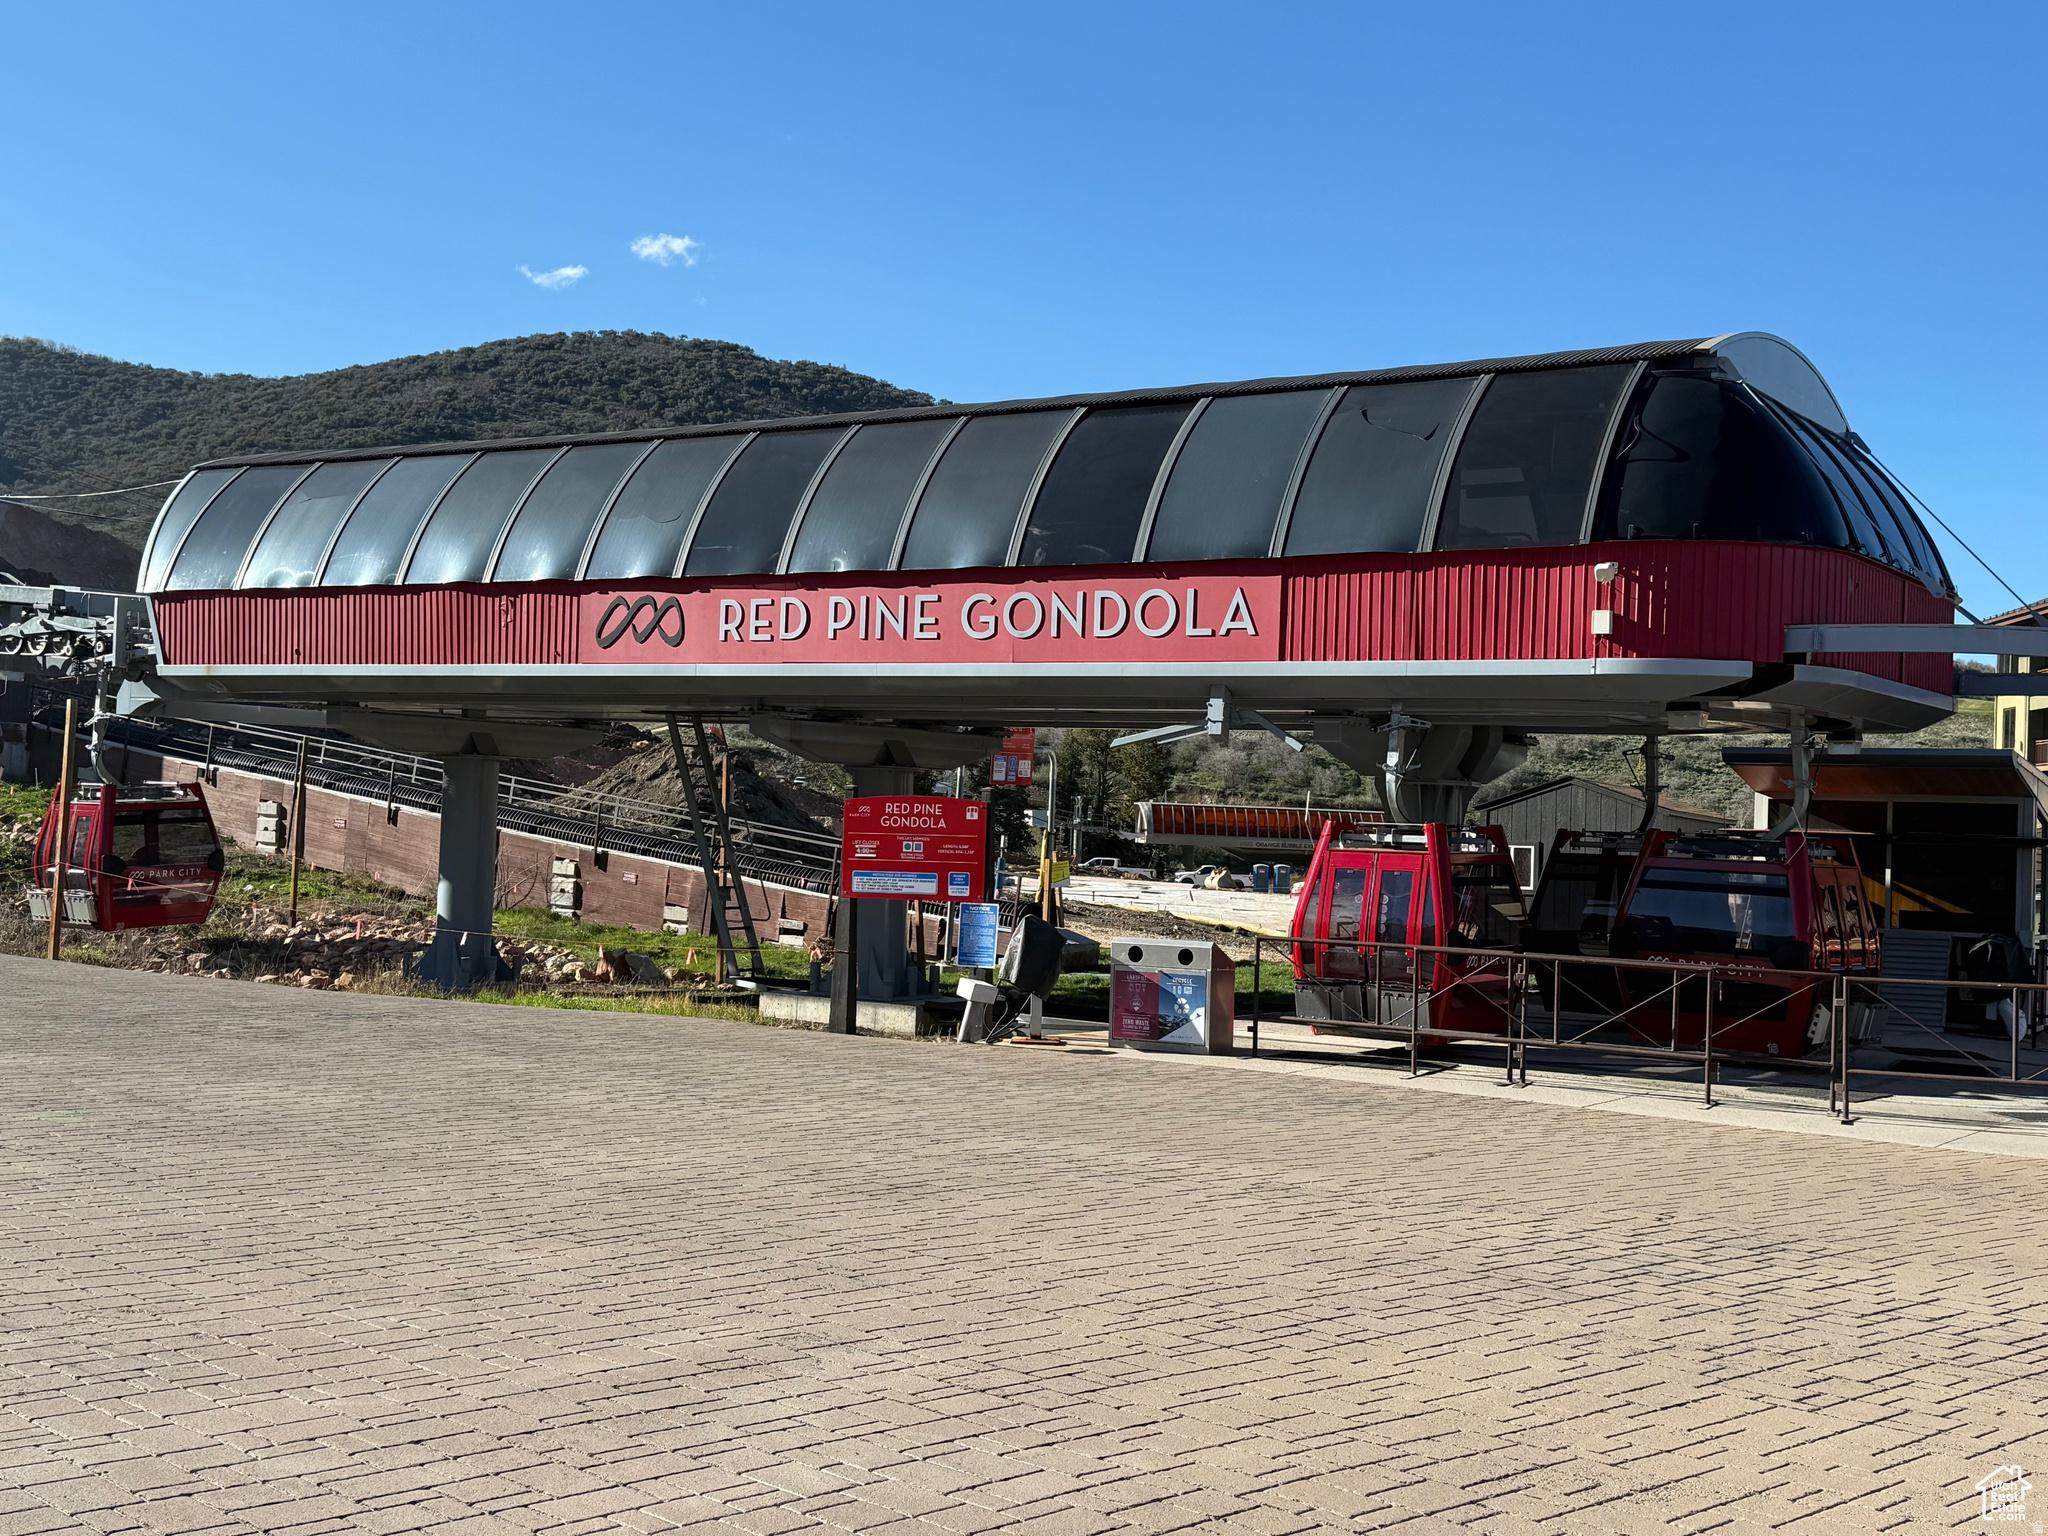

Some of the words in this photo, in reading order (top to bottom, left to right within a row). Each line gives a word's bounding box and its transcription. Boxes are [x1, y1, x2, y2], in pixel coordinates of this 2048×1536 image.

[718, 596, 811, 643] RED
[827, 593, 942, 641] PINE
[960, 587, 1259, 640] GONDOLA
[885, 802, 910, 814] RED
[914, 803, 943, 815] PINE
[880, 816, 946, 828] GONDOLA
[149, 869, 175, 878] PARK
[178, 868, 202, 876] CITY
